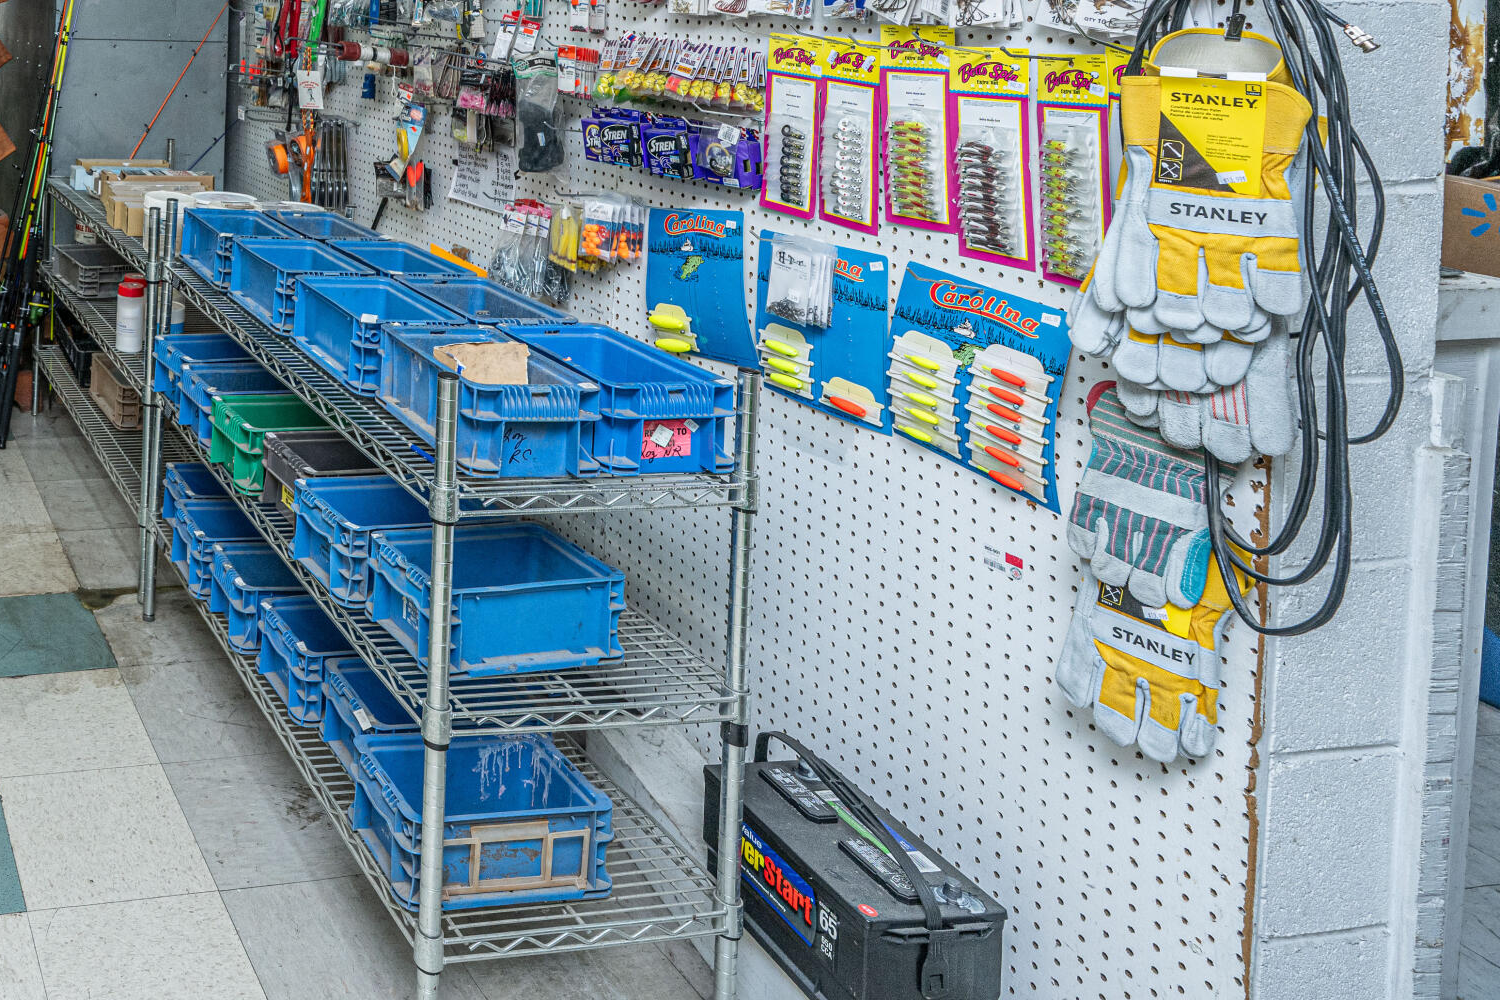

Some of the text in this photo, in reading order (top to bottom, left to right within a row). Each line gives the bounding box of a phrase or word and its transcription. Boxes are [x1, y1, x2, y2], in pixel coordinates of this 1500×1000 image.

[958, 63, 1018, 83] Betts Spin
[1171, 92, 1257, 109] STANLEY
[603, 128, 628, 142] STREN
[650, 140, 675, 152] STREN
[1170, 202, 1268, 225] STANLEY
[664, 213, 726, 238] Carolina
[930, 280, 1039, 338] Carolina
[1112, 626, 1196, 665] STANLEY
[741, 836, 812, 925] erStart
[820, 909, 837, 940] 65
[820, 944, 833, 960] CCA
